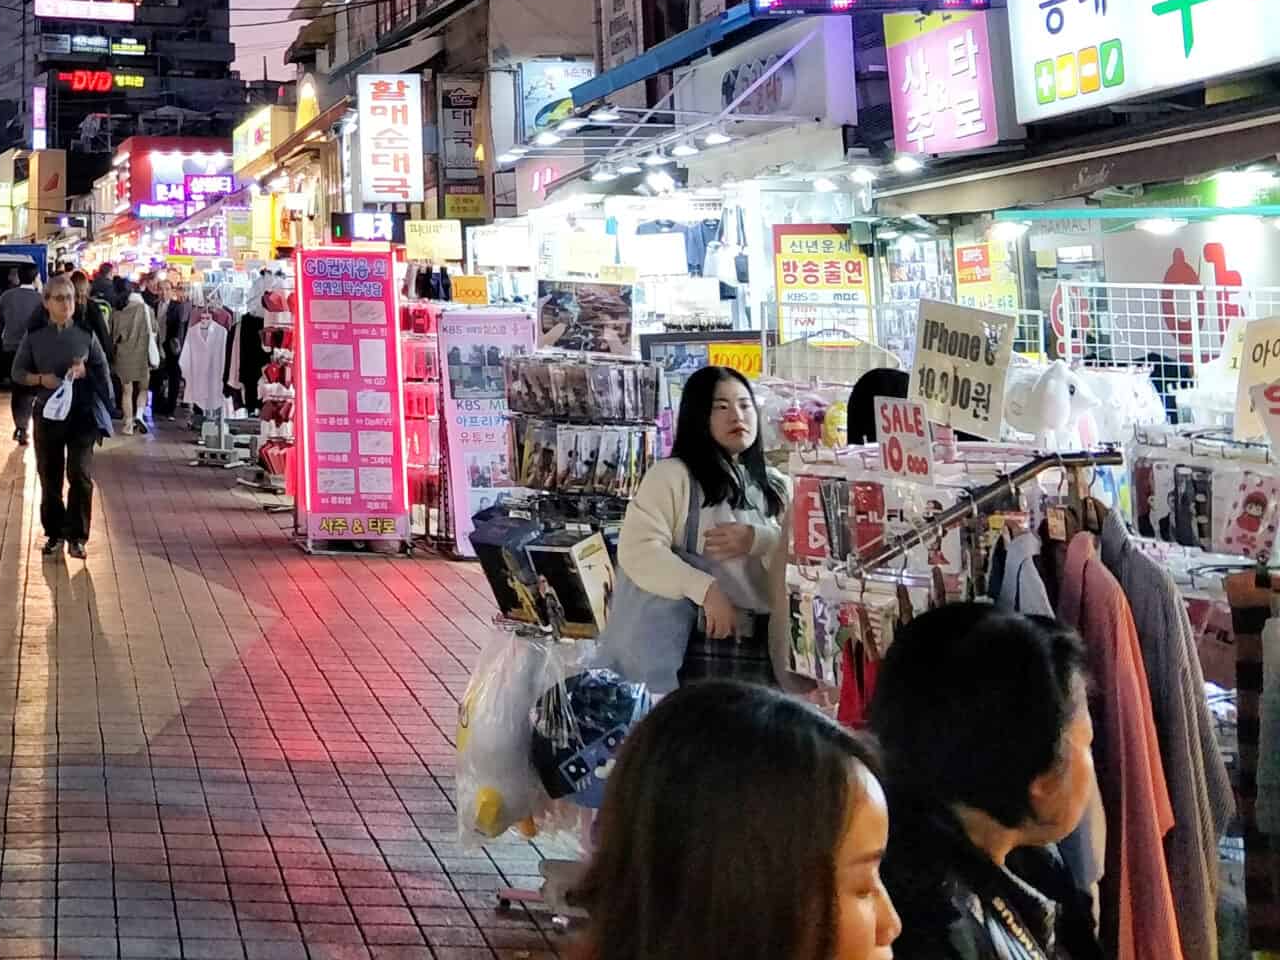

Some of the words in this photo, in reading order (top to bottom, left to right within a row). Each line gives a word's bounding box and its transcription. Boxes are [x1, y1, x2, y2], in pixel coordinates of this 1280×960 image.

[72, 72, 113, 91] DVD
[369, 80, 412, 199] 할매순대국
[782, 260, 864, 285] 방송출연
[787, 292, 809, 302] KBS
[456, 399, 482, 412] KBS
[880, 402, 926, 438] SALE
[319, 517, 348, 534] 사주
[351, 519, 365, 534] &
[368, 517, 396, 534] 타로
